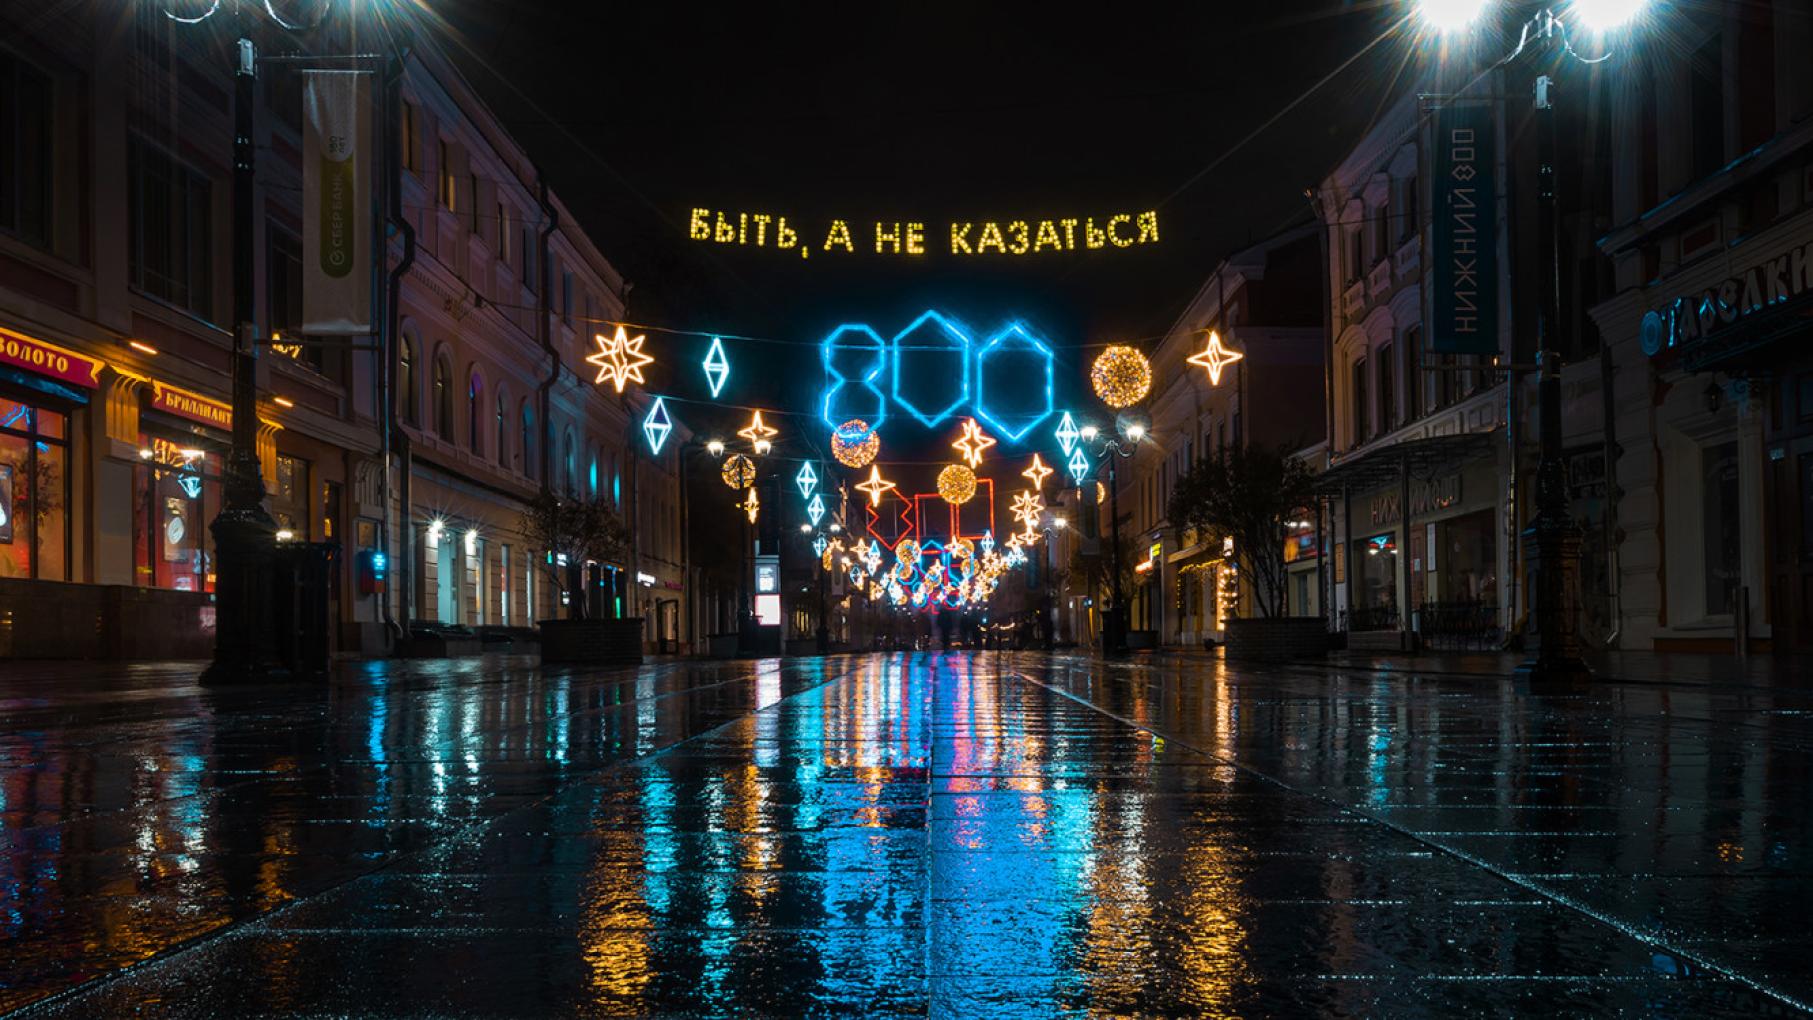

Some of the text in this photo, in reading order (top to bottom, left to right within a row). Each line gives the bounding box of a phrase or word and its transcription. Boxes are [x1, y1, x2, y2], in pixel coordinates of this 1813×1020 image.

[689, 207, 1160, 259] БЫТЬ, А НЕ КАЗАТЬСЯ
[823, 308, 1055, 443] 800
